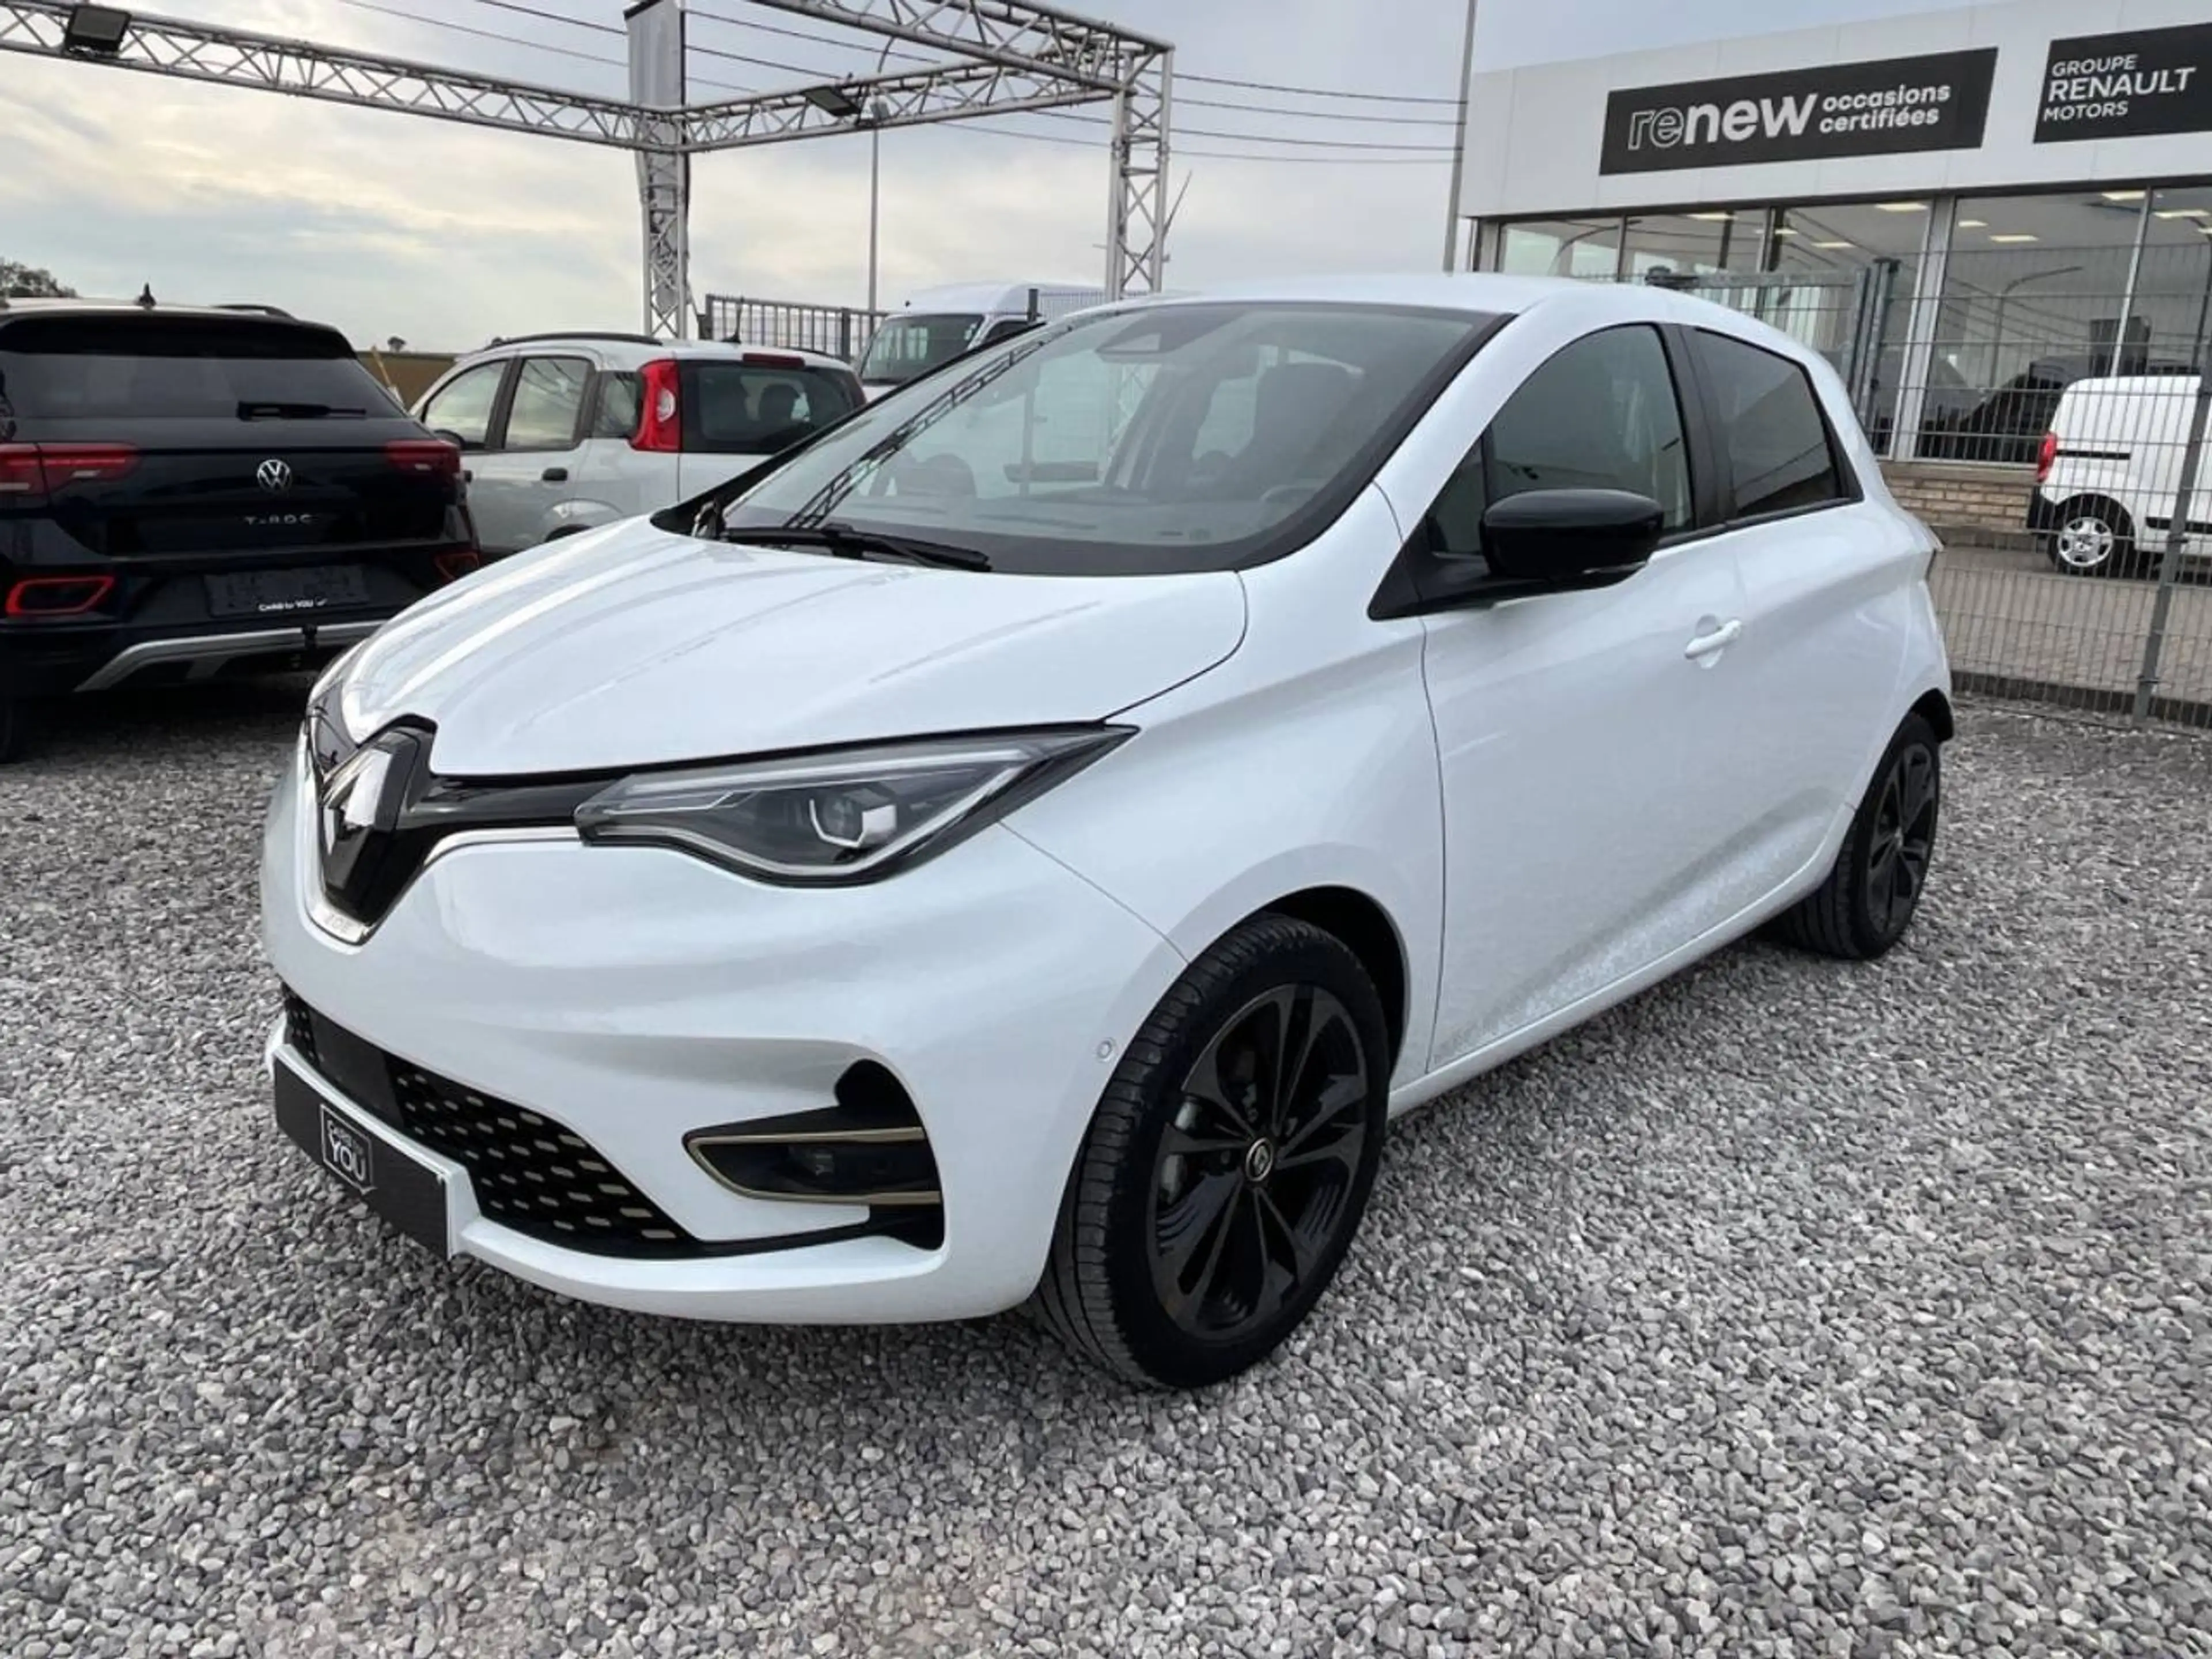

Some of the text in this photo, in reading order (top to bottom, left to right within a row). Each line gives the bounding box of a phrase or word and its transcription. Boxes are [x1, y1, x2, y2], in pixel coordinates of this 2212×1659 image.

[2051, 54, 2138, 77] GROUPE
[1823, 84, 1950, 112] occasions
[2048, 67, 2197, 103] RENAULT
[1628, 93, 1818, 150] renew
[1819, 106, 1940, 133] certifiées
[2044, 101, 2129, 122] MOTORS
[245, 514, 312, 525] T-ROC
[328, 1133, 366, 1181] YOU
